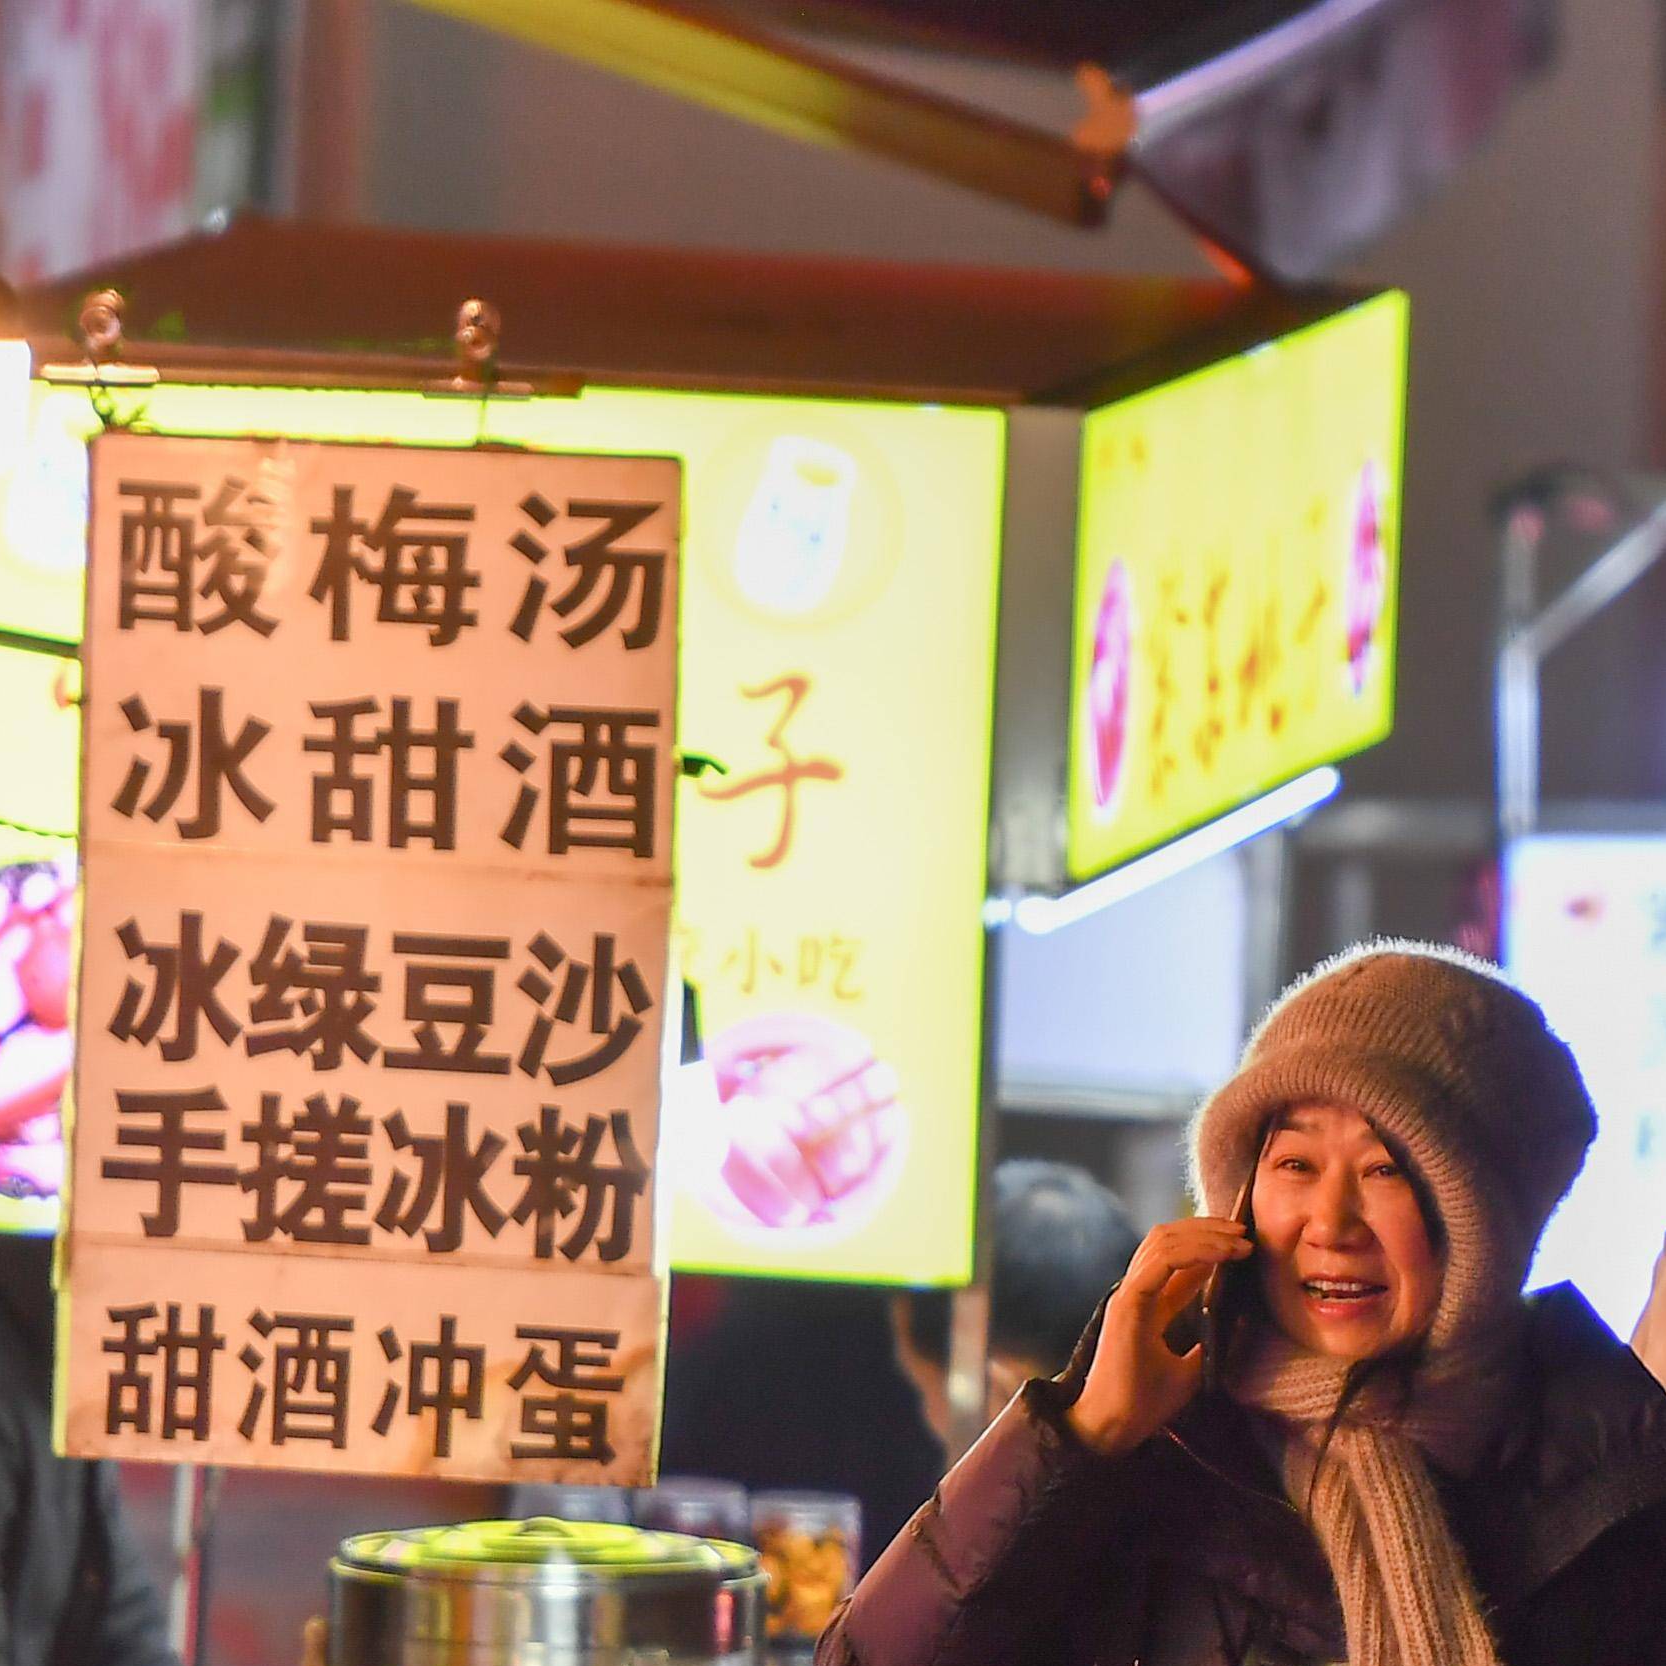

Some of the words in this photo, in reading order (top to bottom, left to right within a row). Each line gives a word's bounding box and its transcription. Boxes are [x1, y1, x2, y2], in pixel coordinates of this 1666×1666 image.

[116, 477, 670, 650] 酸梅汤
[111, 686, 661, 860] 冰甜酒
[108, 909, 654, 1086] 冰绿豆沙
[100, 1086, 649, 1263] 手搓冰粉
[102, 1301, 625, 1466] 甜酒冲蛋
